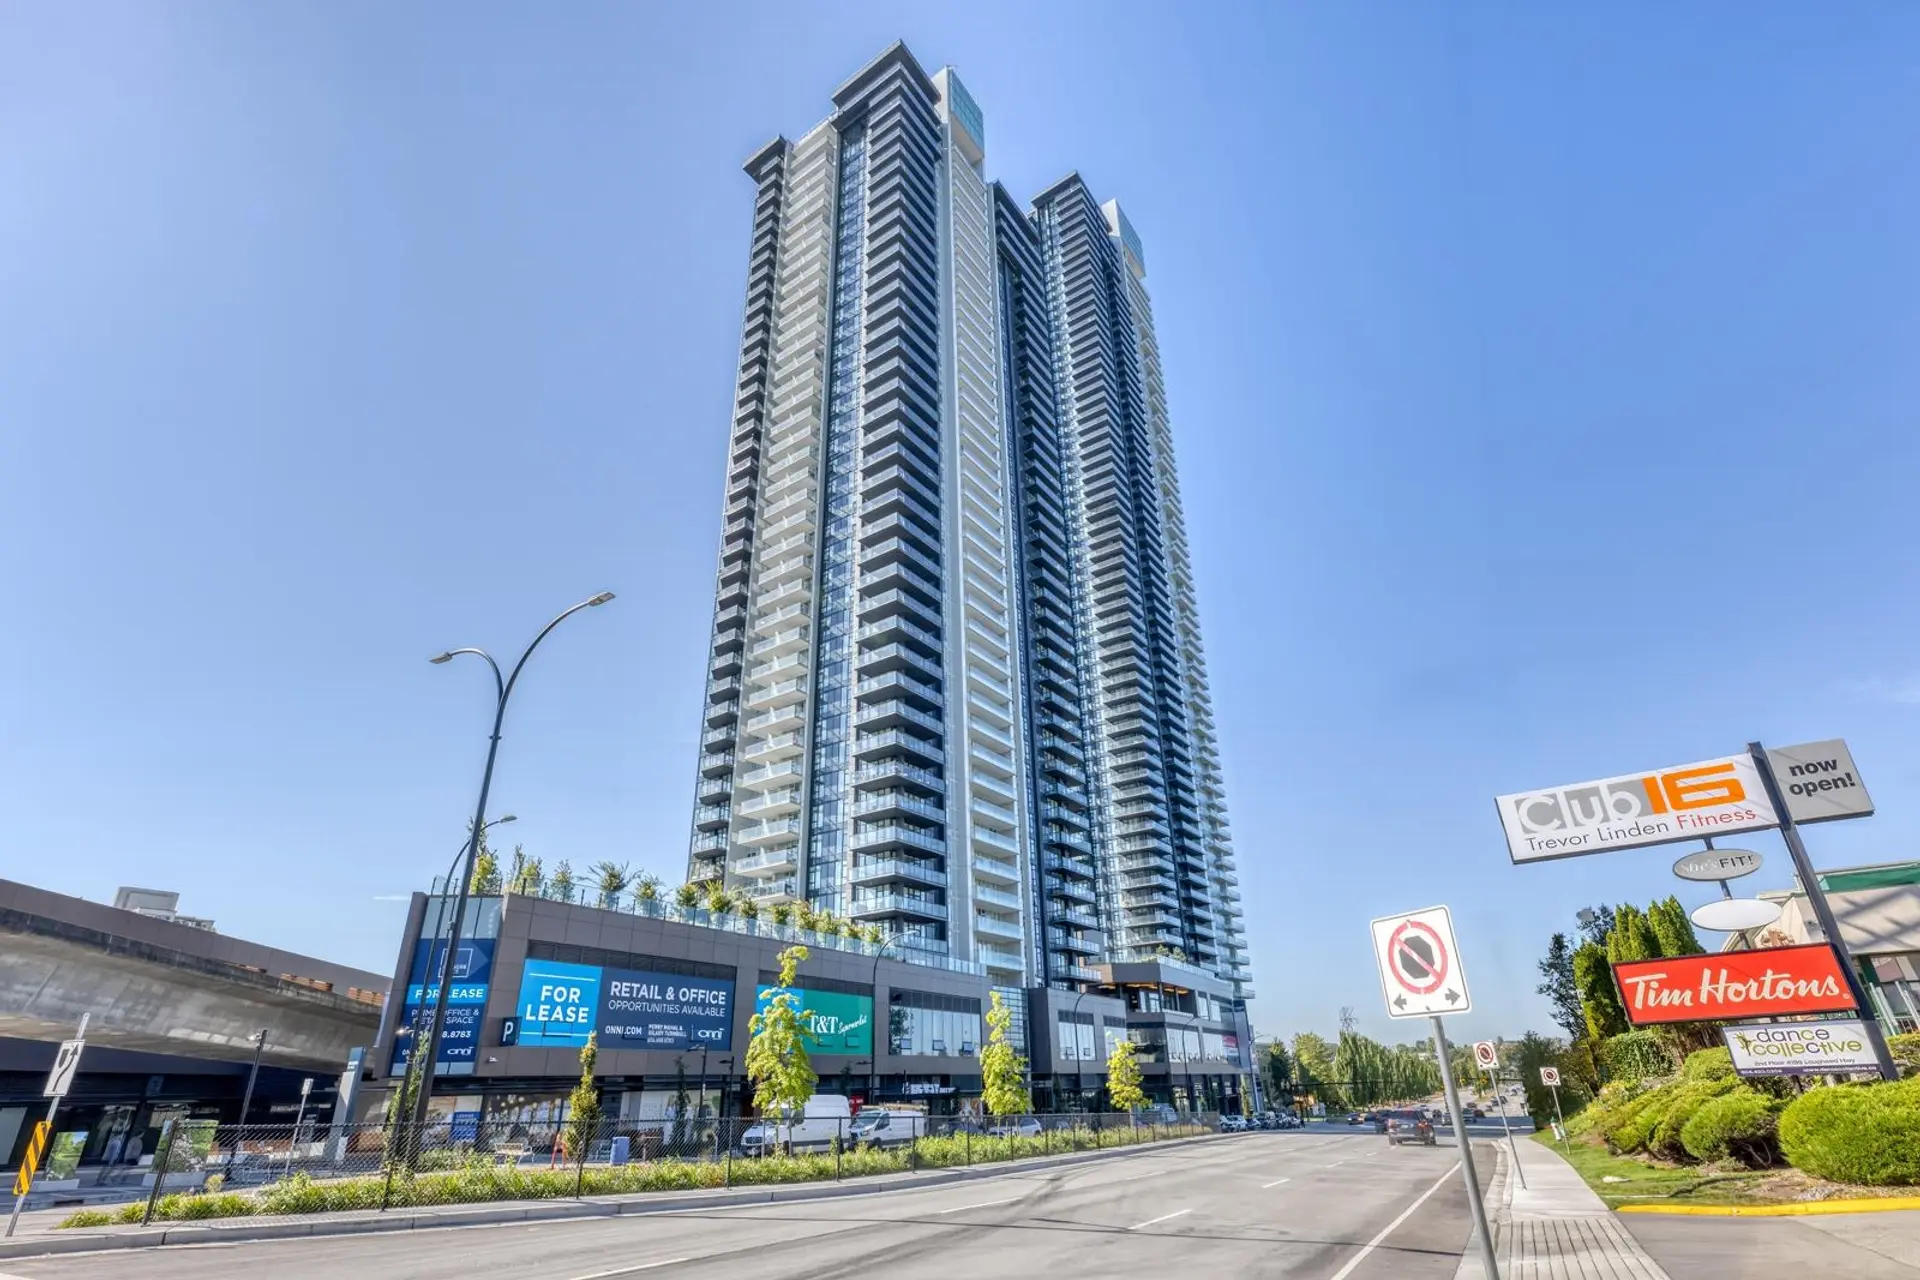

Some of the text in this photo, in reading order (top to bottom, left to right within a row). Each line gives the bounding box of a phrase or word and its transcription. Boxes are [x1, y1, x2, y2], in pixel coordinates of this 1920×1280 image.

[1788, 759, 1838, 777] now
[1789, 772, 1856, 797] open!
[1525, 808, 1757, 851] Trevor Linden Fitness
[448, 988, 484, 998] EASE
[540, 985, 581, 1003] FOR
[610, 981, 726, 1005] RETAIL & OFFICE
[1624, 968, 1840, 1010] Tim Hortons
[525, 1004, 589, 1023] LEASE
[608, 999, 725, 1017] OPPORTUNITIES AVAILABLE
[502, 1021, 514, 1042] P
[604, 1025, 642, 1036] ONNI.COM
[811, 1015, 838, 1034] T&T
[1756, 1028, 1830, 1043] dance
[1753, 1039, 1863, 1057] collective
